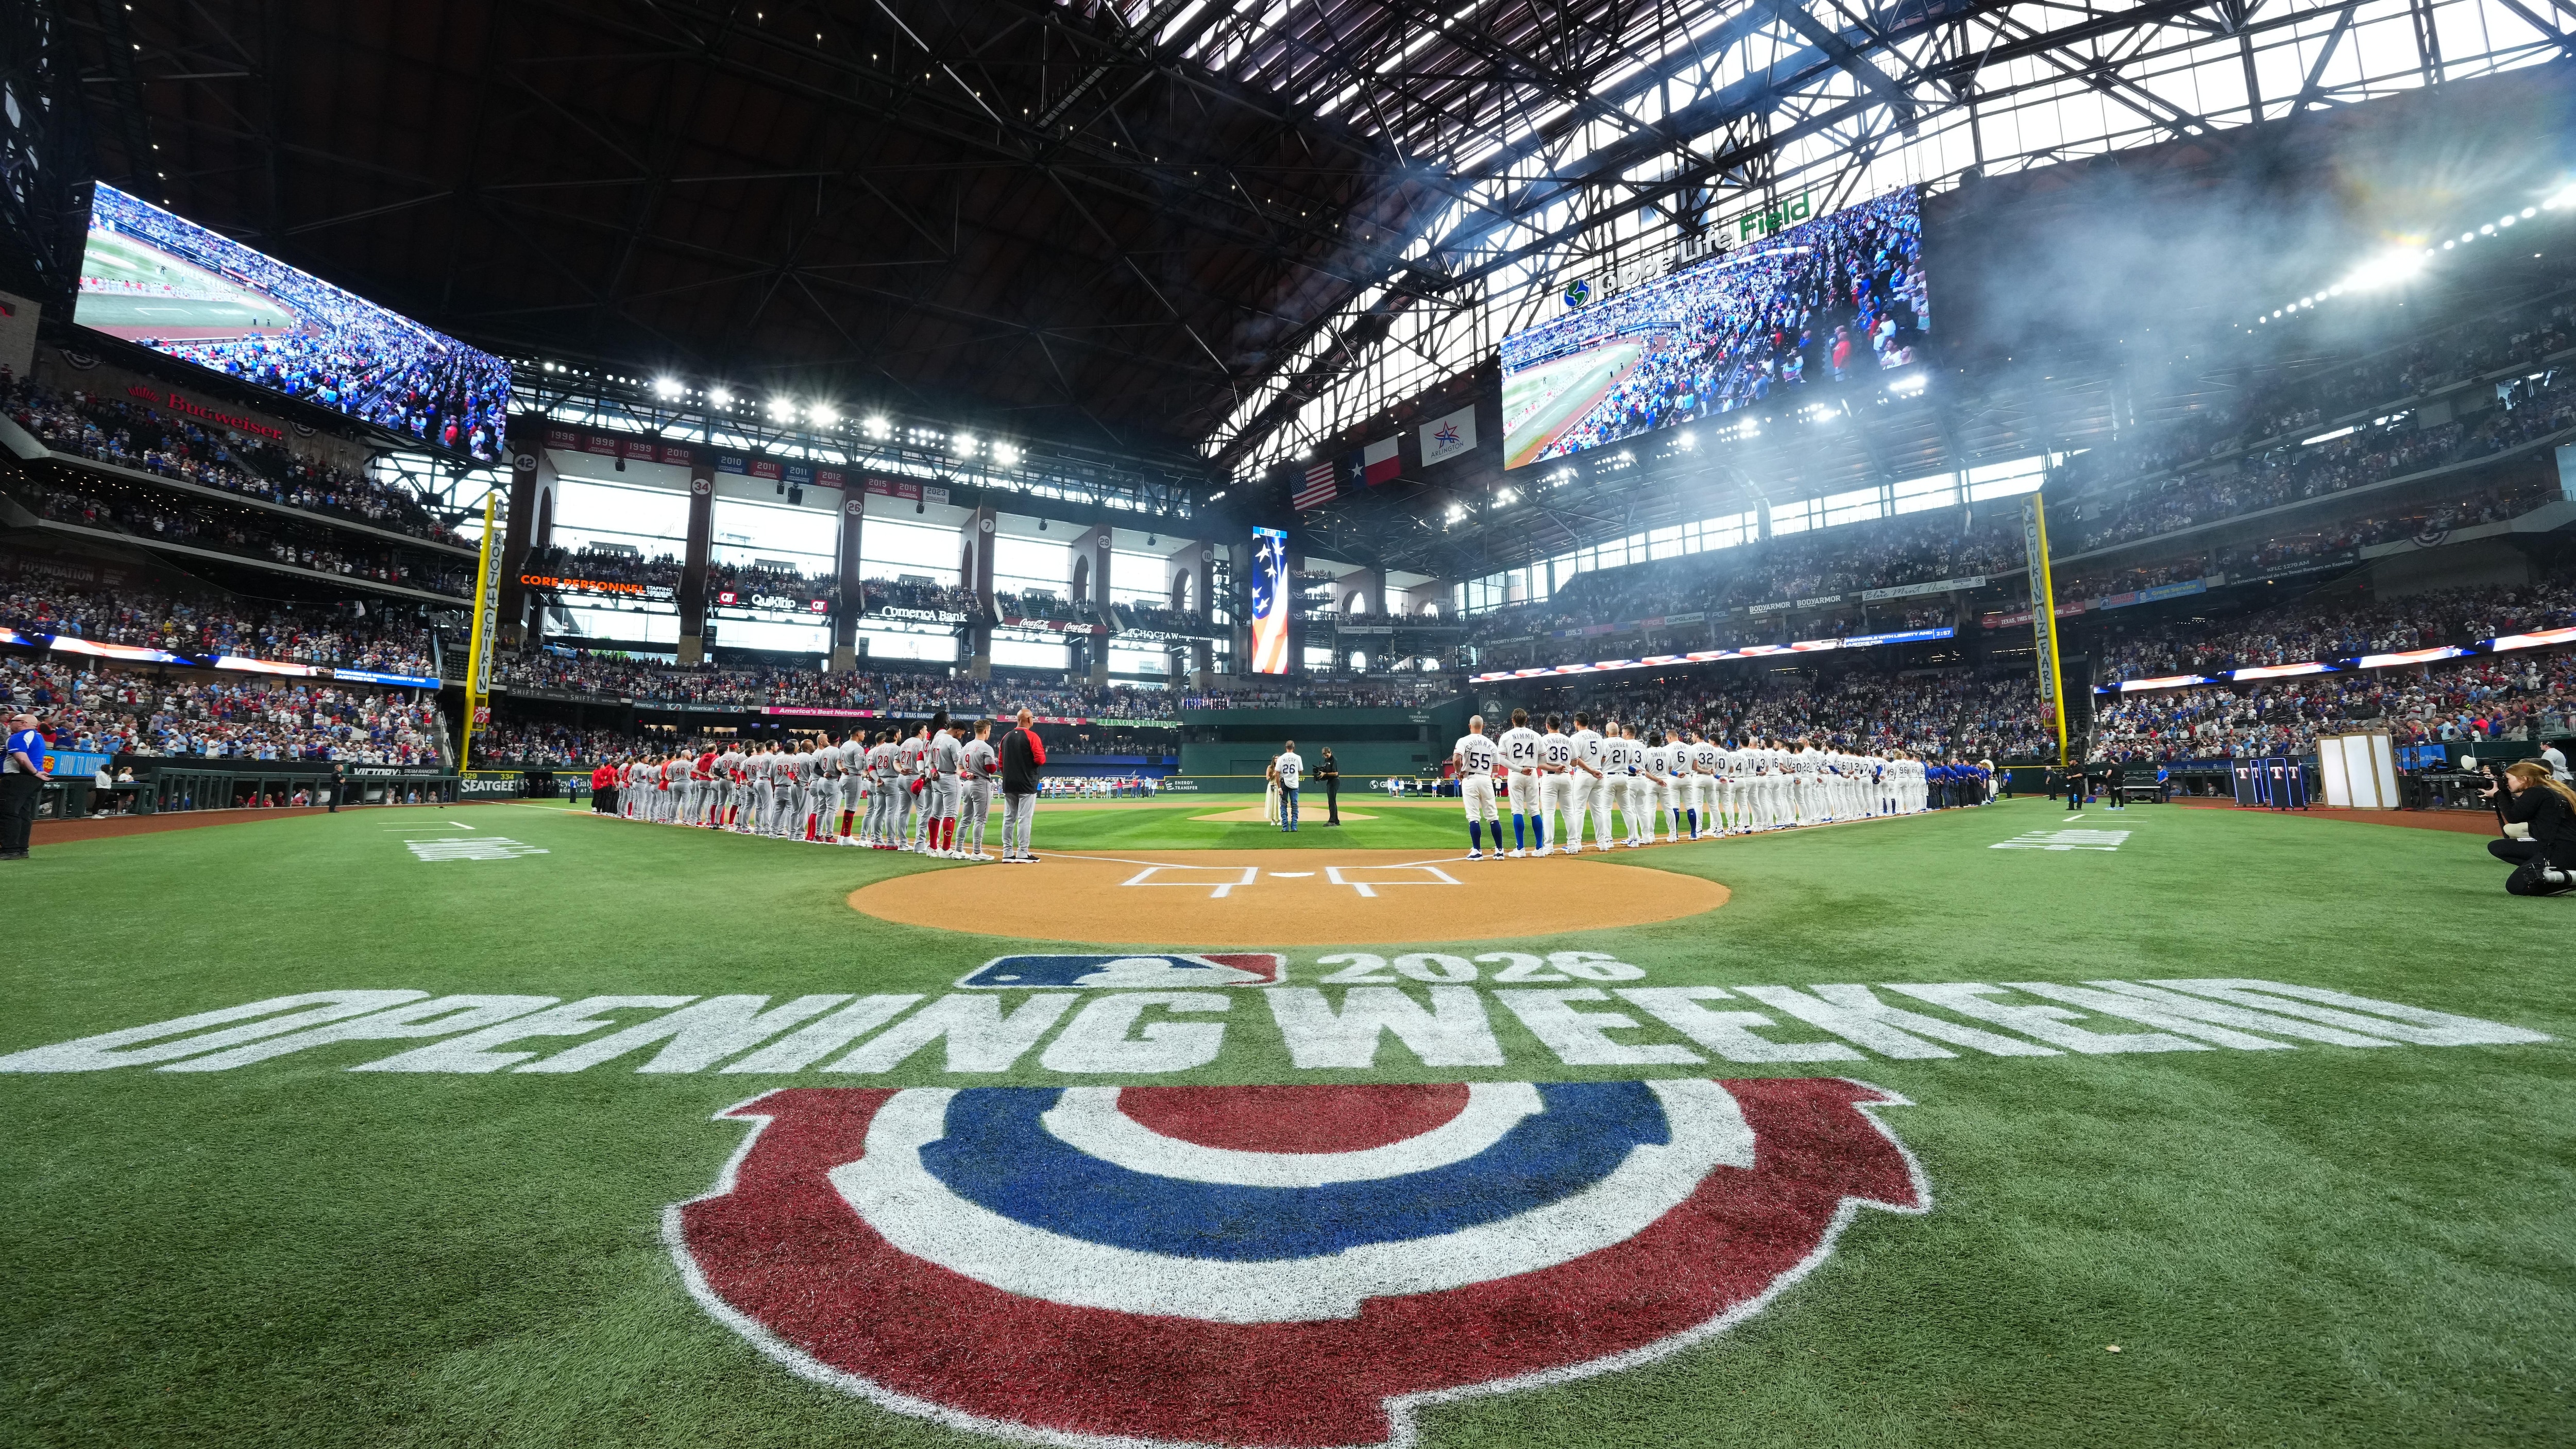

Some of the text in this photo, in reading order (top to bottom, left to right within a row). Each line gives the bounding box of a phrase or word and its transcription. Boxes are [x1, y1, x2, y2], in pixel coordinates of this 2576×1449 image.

[1597, 191, 1811, 295] Globe Life Field
[551, 431, 575, 441] 1996
[592, 436, 615, 447] 1998
[629, 442, 652, 453] 1999
[667, 448, 689, 458] 2010
[1431, 441, 1464, 458] ARLINGTON
[517, 457, 534, 468] 42
[721, 456, 742, 466] 2010
[757, 462, 775, 471] 2011
[790, 467, 807, 476] 2011
[822, 471, 841, 481] 2012
[694, 482, 709, 492] 34
[869, 479, 887, 488] 2015
[899, 483, 917, 492] 2016
[927, 487, 946, 496] 2023
[848, 502, 861, 512] 26
[985, 521, 991, 530] 7
[490, 532, 501, 584] ROOT
[2026, 526, 2042, 601] CHIKIN
[2332, 559, 2353, 568] Español
[19, 560, 94, 582] FOUNDATION
[520, 575, 646, 594] CORE PERSONNEL
[1865, 591, 1889, 600] Blue
[1891, 585, 1923, 595] Mint
[1927, 583, 1951, 592] Thai
[2110, 593, 2135, 602] BAKER
[720, 593, 735, 603] QT
[751, 594, 796, 609] QuikTrip
[1797, 595, 1841, 607] BODYARMOR
[812, 601, 825, 610] QT
[1749, 601, 1791, 612] BODYARMOR
[938, 610, 968, 622] Bank
[1666, 614, 1702, 623] GoPGL.com
[2038, 608, 2046, 634] IZ
[1019, 618, 1050, 630] Coca-Cola
[1064, 622, 1093, 634] Coca-Cola
[1132, 628, 1179, 640] CHOCTAW
[1510, 635, 1534, 643] COMMERCE
[479, 611, 494, 691] CHIKIN
[2040, 641, 2052, 696] FARE
[1545, 737, 1573, 746] LANGFORD
[1513, 742, 1534, 759] 24
[1549, 746, 1568, 761] 36
[1590, 741, 1597, 755] 5
[901, 750, 911, 765] 27
[933, 747, 940, 763] 17
[1469, 752, 1490, 770] 55
[1613, 749, 1626, 763] 21
[1677, 751, 1685, 763] 6
[1699, 753, 1714, 764] 32
[59, 755, 84, 775] HOW TO
[722, 759, 732, 769] 30
[822, 757, 828, 770] 3
[877, 755, 889, 769] 28
[964, 753, 971, 771] 9
[1656, 758, 1664, 771] 8
[1772, 758, 1779, 768] 16
[675, 767, 685, 776] 46
[747, 764, 756, 775] 76
[777, 764, 789, 776] 93
[1283, 764, 1295, 774] 26
[1899, 766, 1908, 775] 96
[2235, 768, 2250, 780] T
[2253, 767, 2259, 778] T
[2270, 766, 2284, 780] T
[2289, 766, 2299, 779] T
[1318, 951, 1647, 984] 2026
[0, 978, 2553, 1073] OPENING WEEKEND
